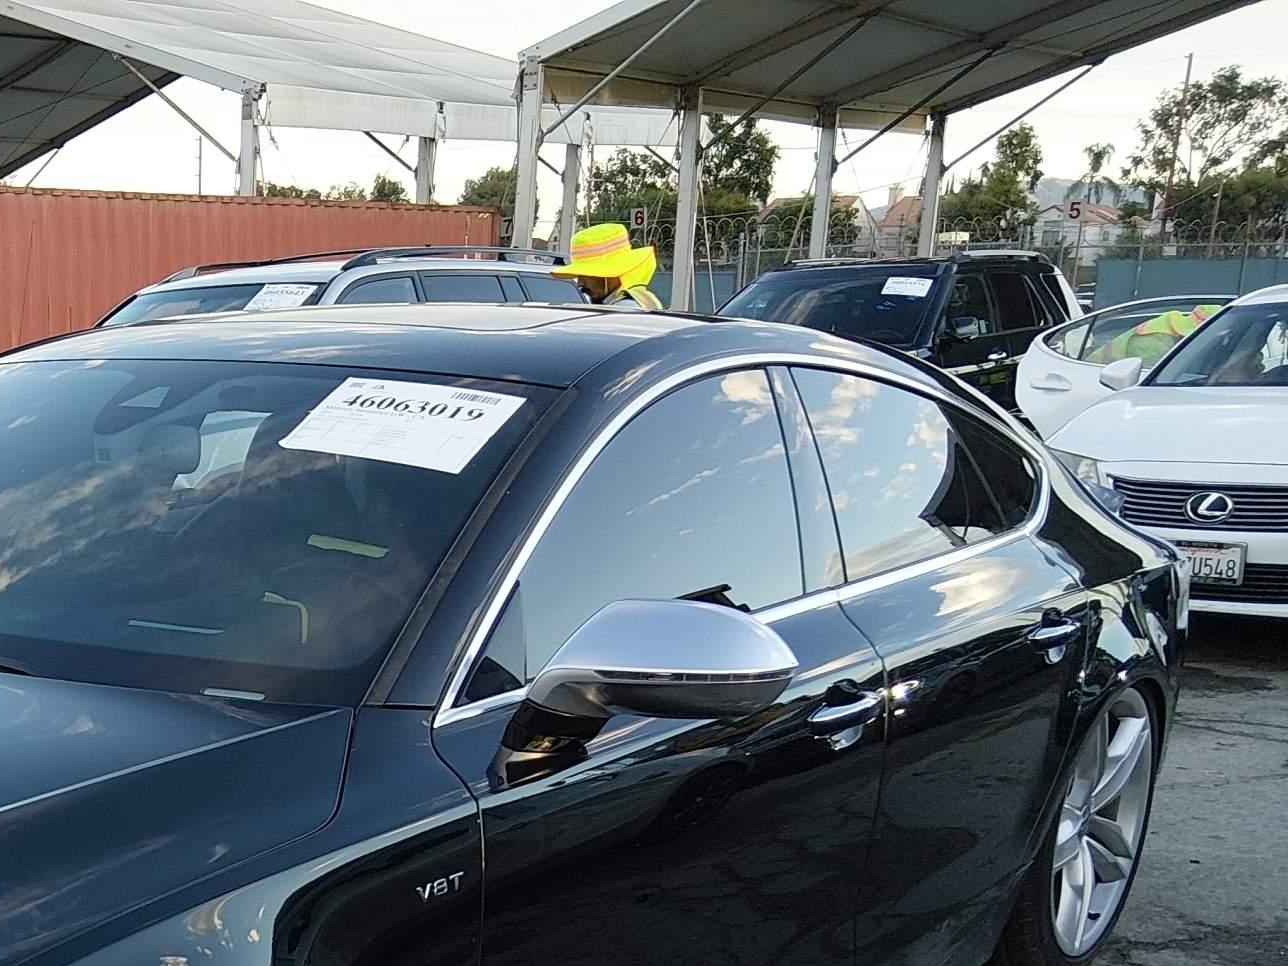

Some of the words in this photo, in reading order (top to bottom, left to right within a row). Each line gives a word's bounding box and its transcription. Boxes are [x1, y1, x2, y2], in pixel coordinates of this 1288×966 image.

[634, 211, 644, 225] 6
[1069, 201, 1081, 219] 5
[503, 219, 512, 234] 7
[343, 393, 486, 422] 46063019
[1186, 556, 1236, 577] U548
[415, 871, 465, 903] V8T
